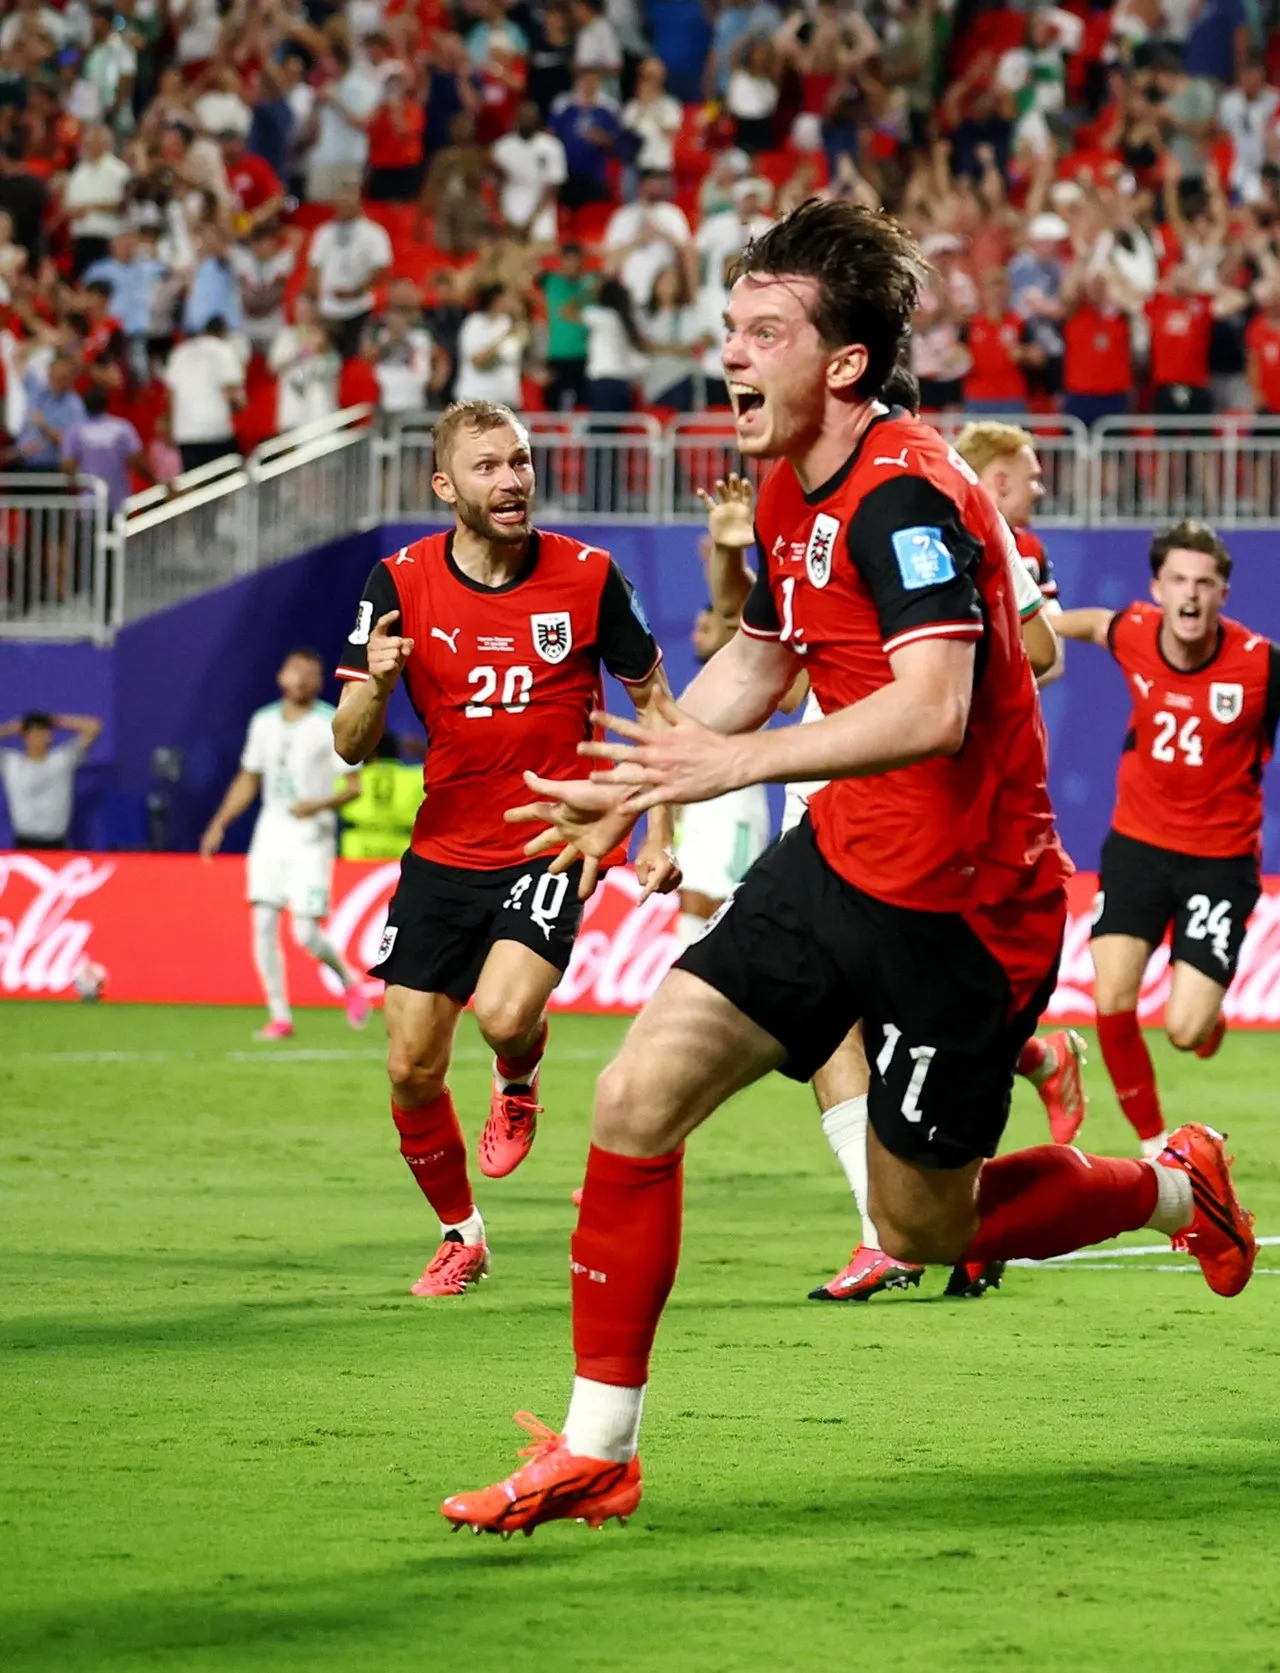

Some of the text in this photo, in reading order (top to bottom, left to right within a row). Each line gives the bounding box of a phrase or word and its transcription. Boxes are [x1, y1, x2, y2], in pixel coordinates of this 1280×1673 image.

[465, 665, 534, 719] 20
[1151, 711, 1204, 767] 24
[1184, 893, 1232, 949] 24
